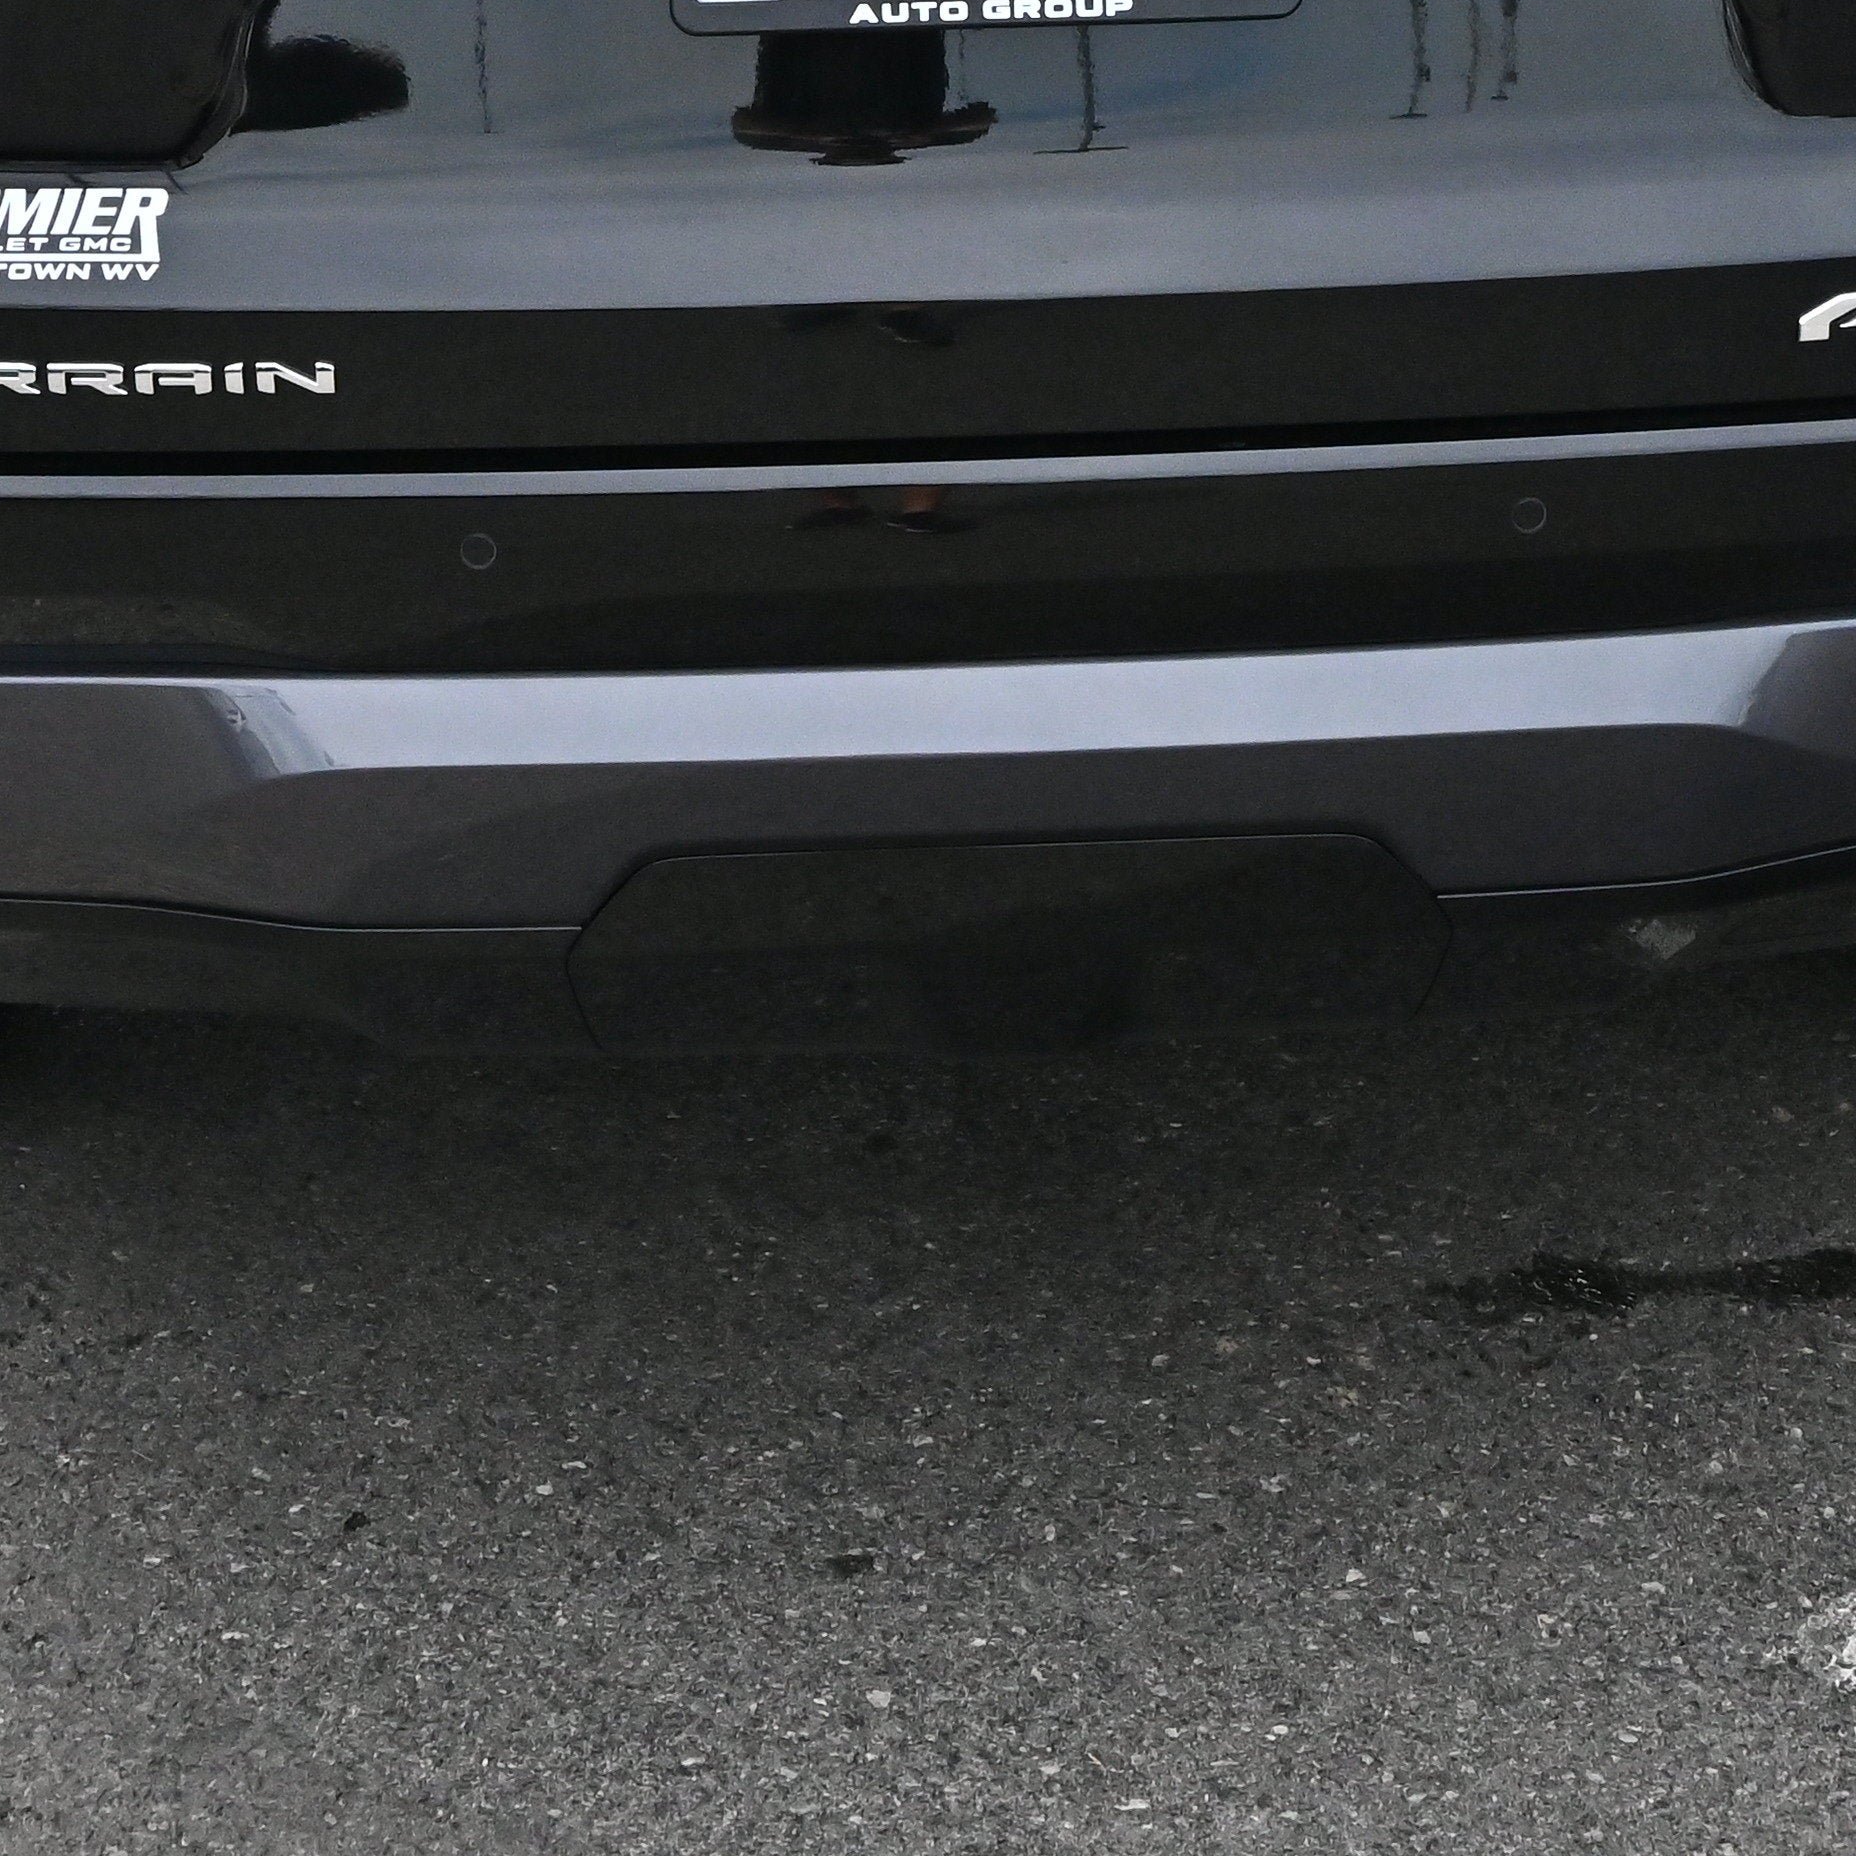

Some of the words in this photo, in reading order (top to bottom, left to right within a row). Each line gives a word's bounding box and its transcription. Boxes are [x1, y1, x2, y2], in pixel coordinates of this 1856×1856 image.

[849, 0, 970, 25] AUTO
[58, 237, 132, 252] GMC
[101, 262, 160, 282] WV
